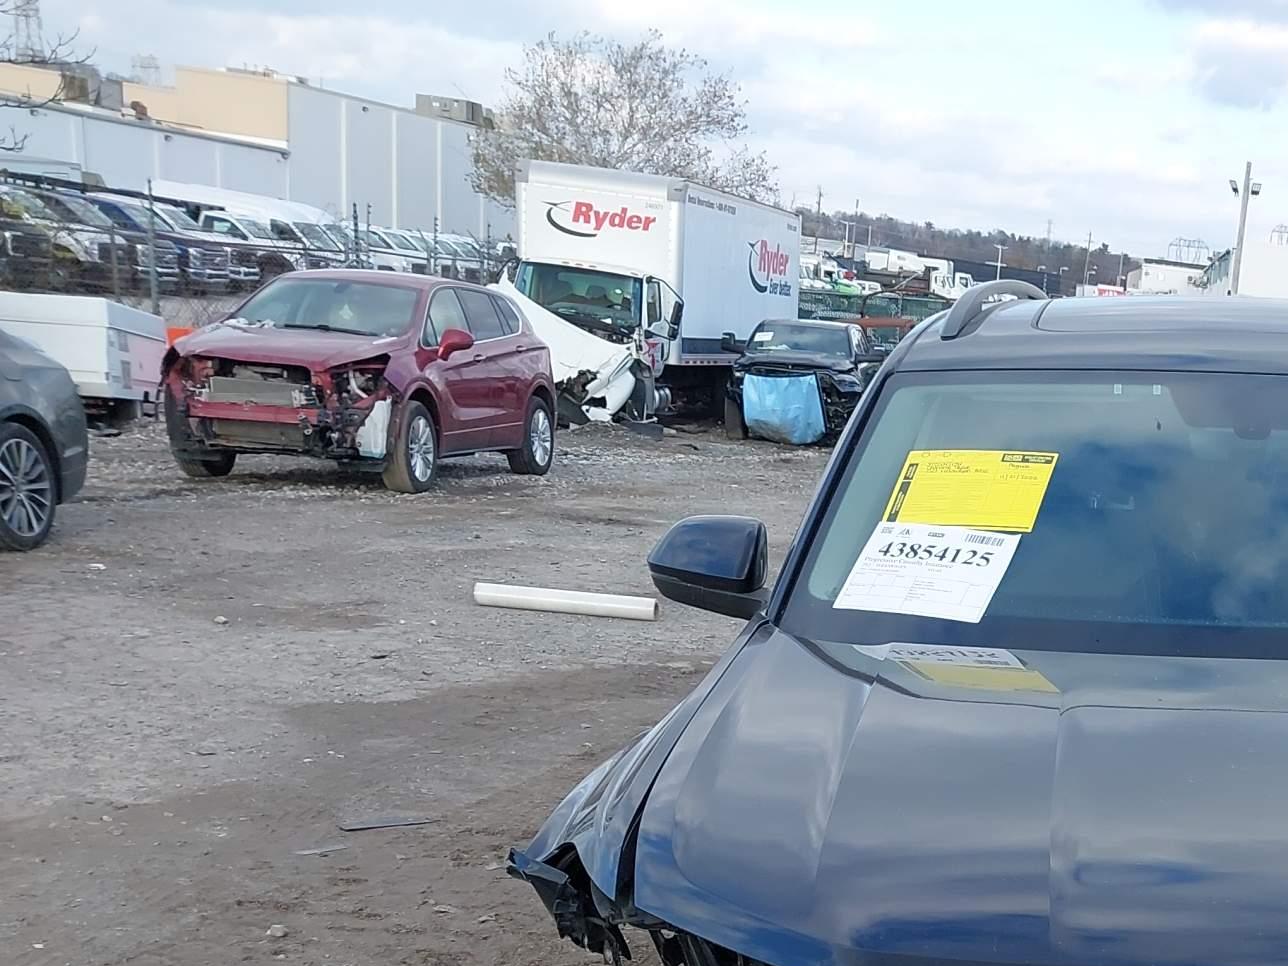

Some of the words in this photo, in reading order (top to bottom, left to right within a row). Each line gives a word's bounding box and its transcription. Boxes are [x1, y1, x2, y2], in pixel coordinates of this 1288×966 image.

[572, 201, 657, 231] Ryder
[758, 239, 790, 281] Ryder
[878, 540, 995, 568] 43854125
